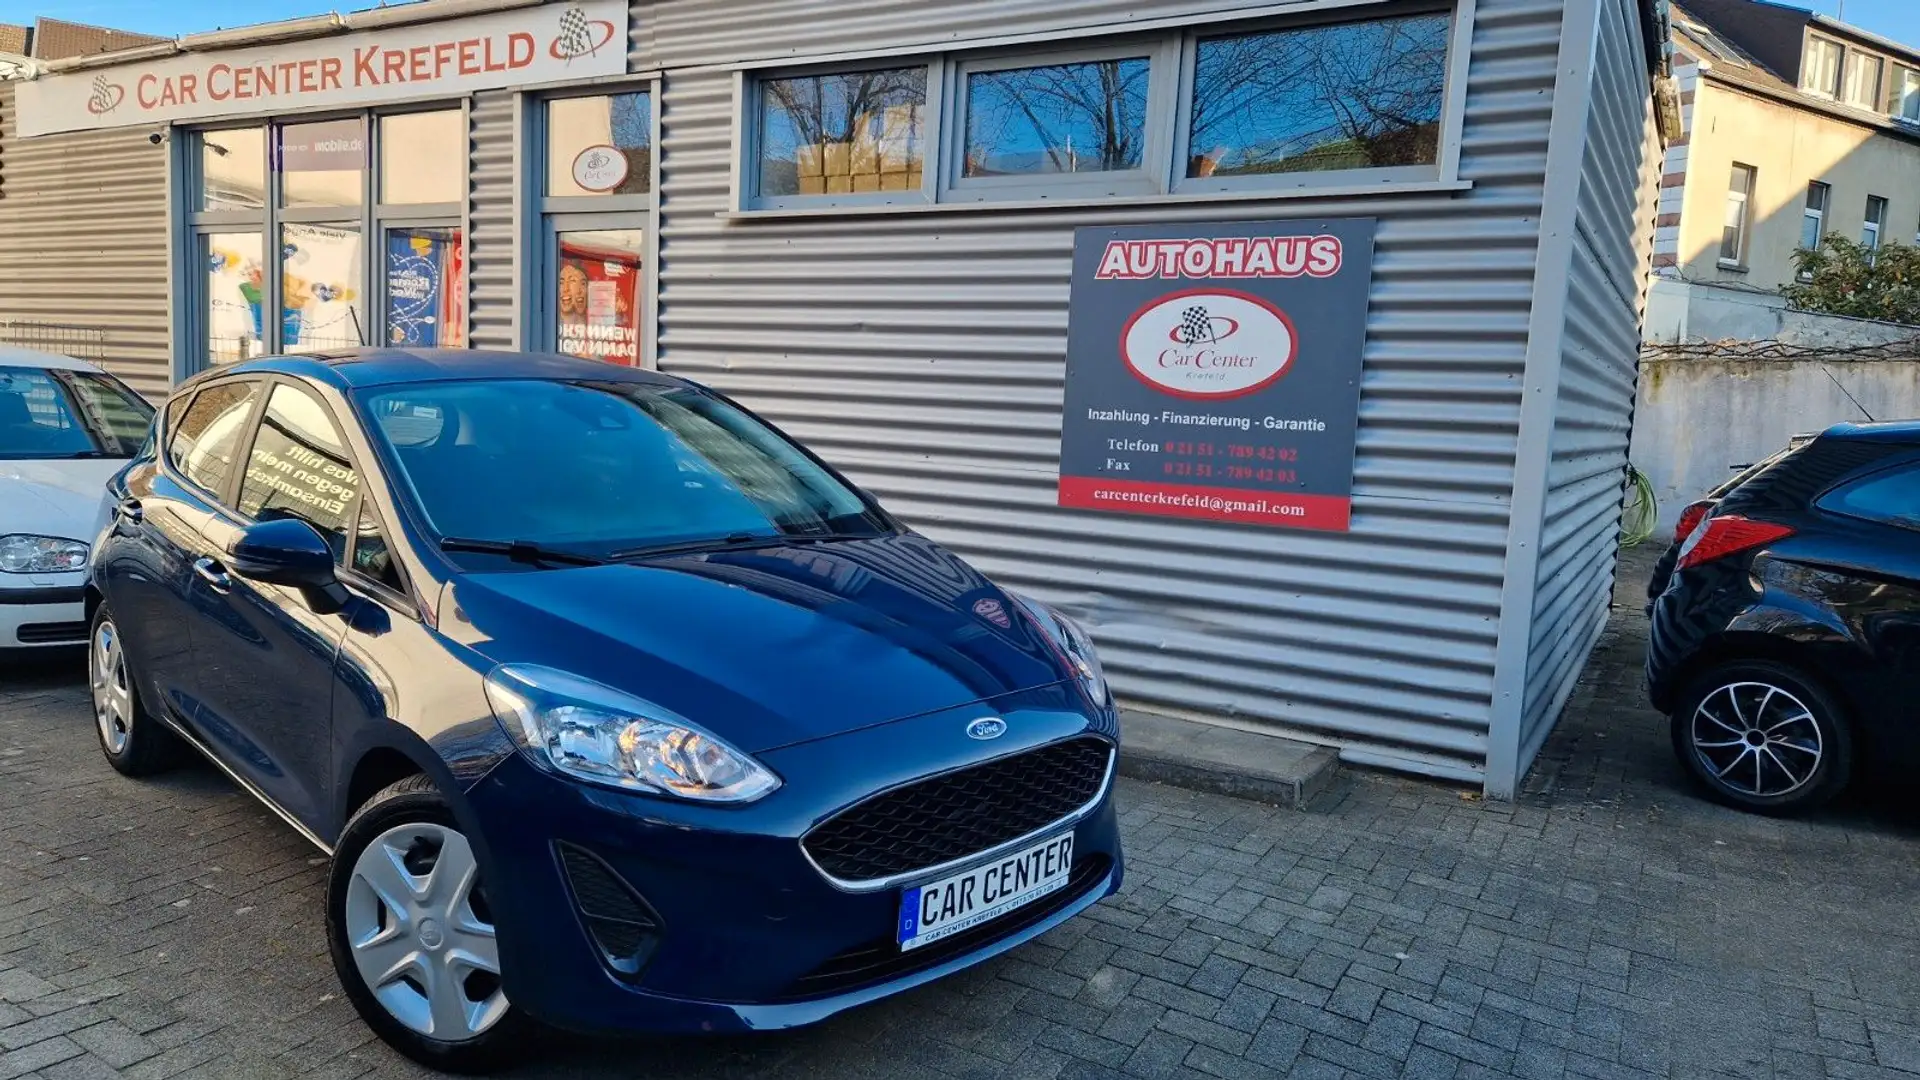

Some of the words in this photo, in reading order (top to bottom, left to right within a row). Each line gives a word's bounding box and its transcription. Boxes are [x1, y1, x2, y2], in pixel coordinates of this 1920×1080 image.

[136, 73, 197, 110] CAR
[206, 57, 342, 101] CENTER
[354, 32, 535, 87] KREFELD
[1095, 235, 1342, 279] AUTOHAUS
[1158, 349, 1193, 368] Car
[1195, 349, 1258, 368] Center
[1088, 408, 1150, 425] Inzahlung
[1162, 411, 1250, 430] Finanzierung
[1264, 416, 1326, 431] Garantie
[1107, 439, 1159, 453] Telefon
[1106, 458, 1131, 471] Fax
[1093, 487, 1305, 516] carcenterkrefeld@gmail.com
[922, 875, 976, 927] CAR
[983, 836, 1072, 904] CENTER
